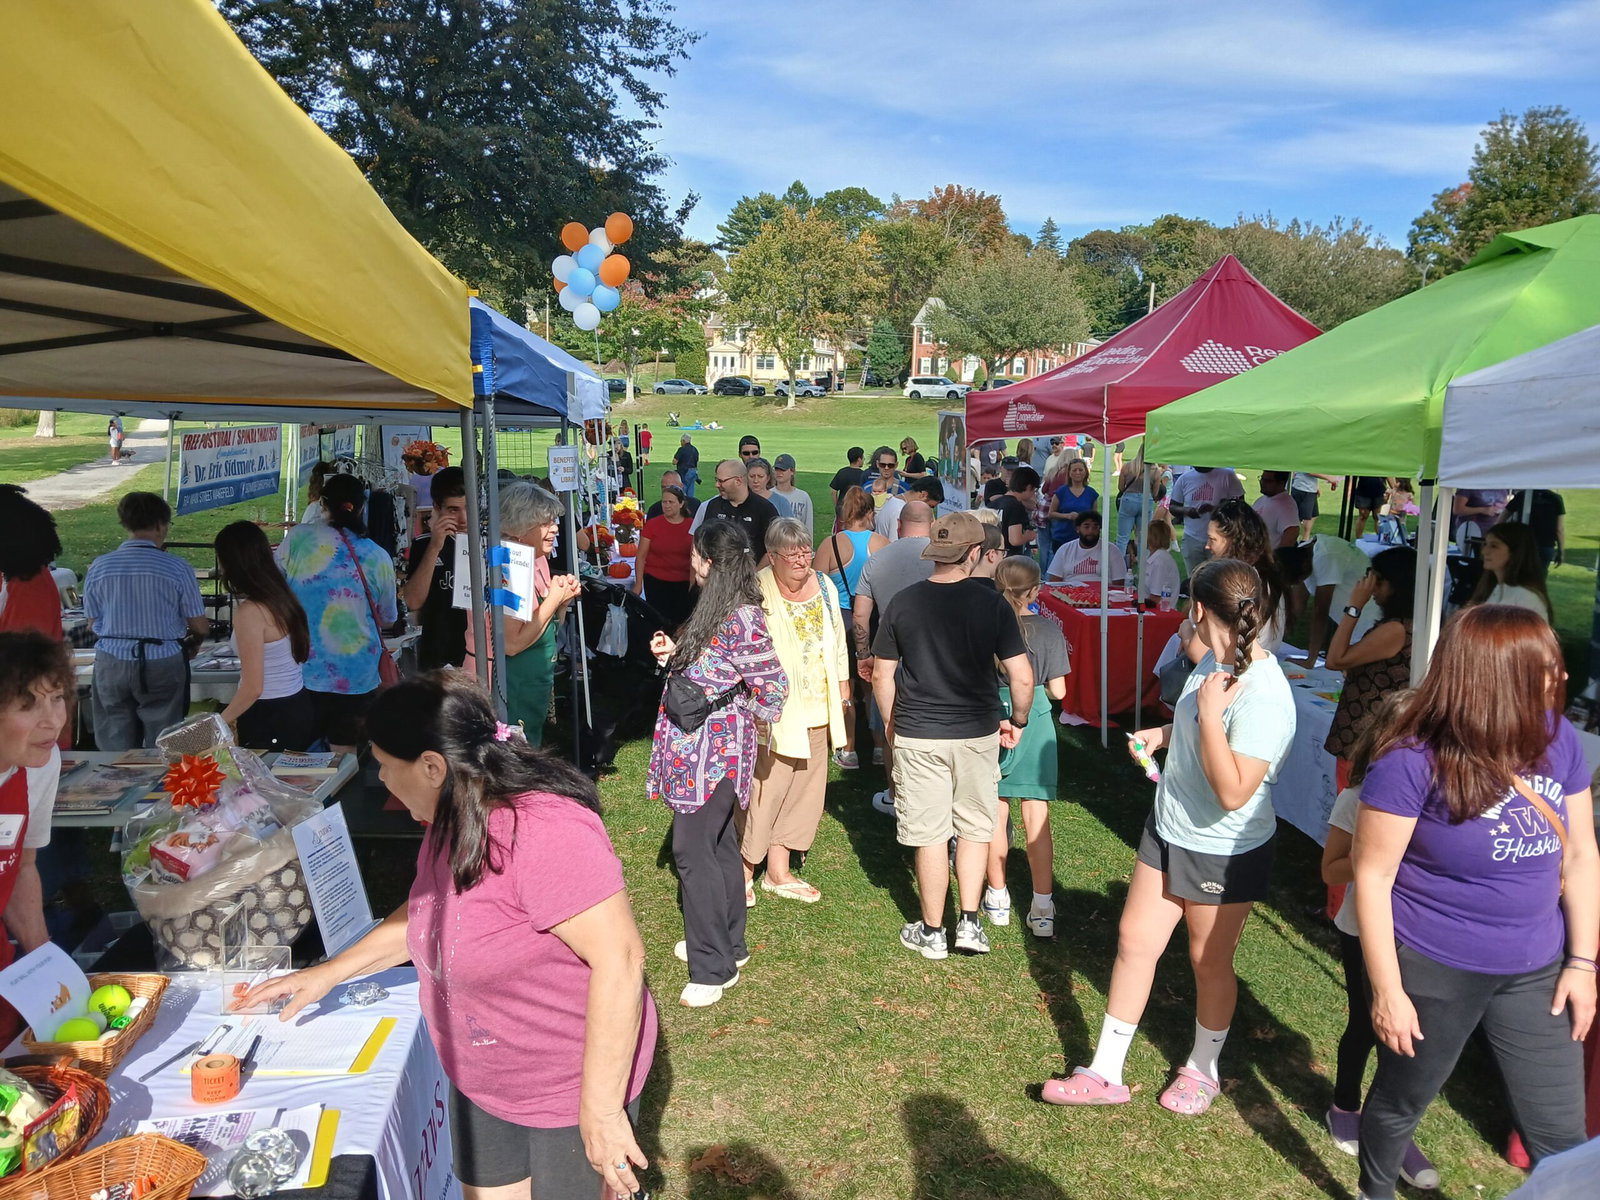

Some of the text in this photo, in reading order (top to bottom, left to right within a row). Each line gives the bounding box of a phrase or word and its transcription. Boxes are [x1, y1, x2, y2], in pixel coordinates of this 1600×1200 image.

[1017, 402, 1037, 413] Reading
[1016, 412, 1045, 422] Cooperative
[208, 461, 223, 480] Eric
[511, 559, 531, 569] riends!
[1508, 805, 1550, 837] W
[203, 1076, 225, 1086] TICKET
